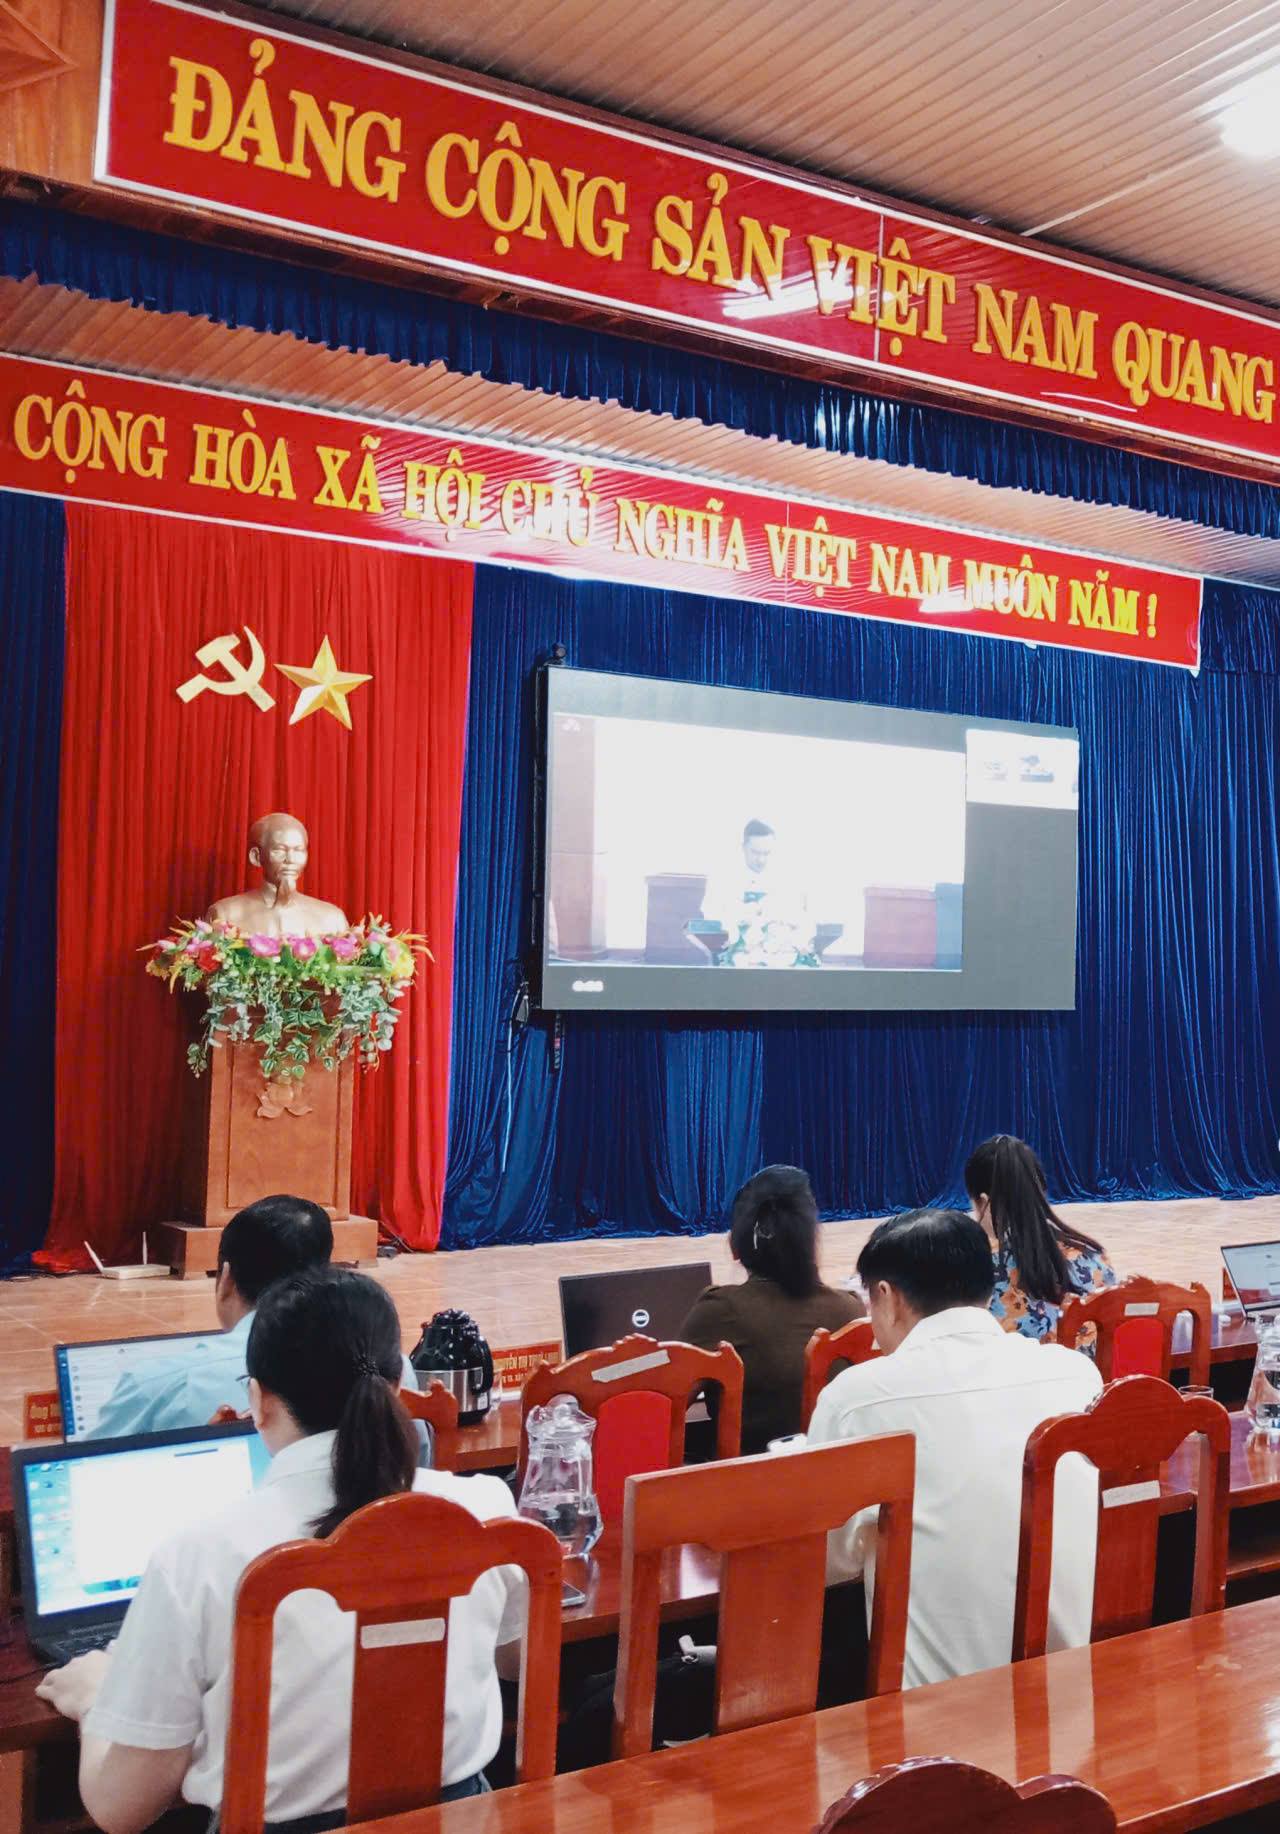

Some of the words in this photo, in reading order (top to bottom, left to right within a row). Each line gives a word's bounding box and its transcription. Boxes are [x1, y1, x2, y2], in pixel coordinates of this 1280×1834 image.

[163, 39, 406, 203] ĐẢNG
[425, 121, 630, 260] CỘNG
[652, 174, 790, 300] SẢN
[807, 236, 956, 356] VIỆT
[973, 285, 1098, 378] NAM
[1113, 322, 1276, 423] QUANG
[14, 381, 166, 482] CỘNG
[190, 411, 295, 500] HÒA
[315, 436, 383, 514] XÃ
[400, 449, 485, 541] HỘI
[502, 467, 600, 547] CHỦ
[616, 499, 749, 572] NGHĨA
[765, 517, 857, 597] VIỆT
[871, 543, 951, 600] NAM
[964, 555, 1058, 622] MUÔN
[1069, 570, 1139, 636] NĂM
